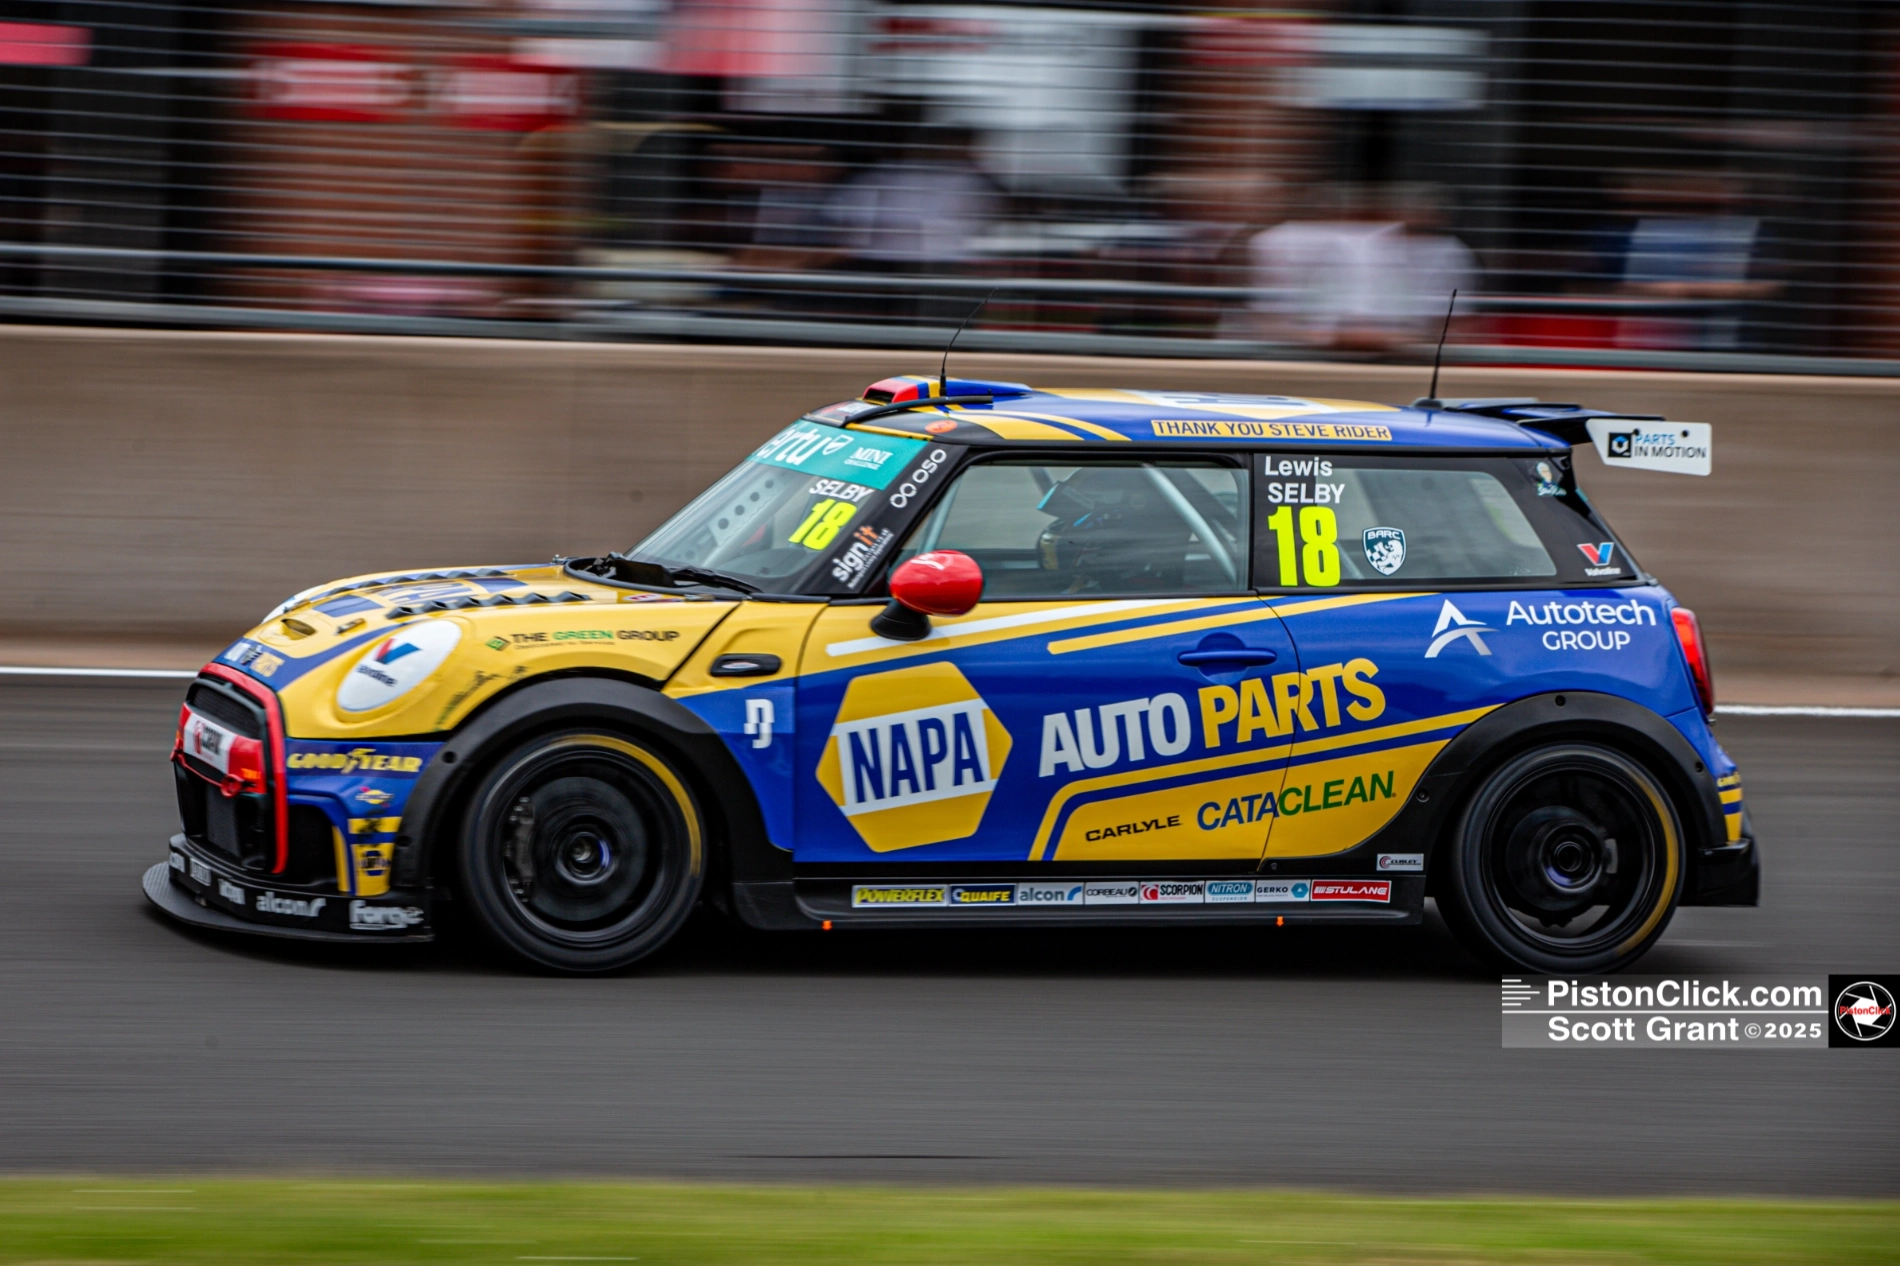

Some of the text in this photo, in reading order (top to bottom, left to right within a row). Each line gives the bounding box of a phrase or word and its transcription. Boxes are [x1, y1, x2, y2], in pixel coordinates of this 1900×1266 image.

[1154, 421, 1389, 439] THANK YOU STEVE RIDER
[1635, 434, 1676, 446] PARTS
[1634, 446, 1708, 458] IN MOTION
[1265, 455, 1333, 477] Lewis
[809, 479, 875, 502] SELBY
[1267, 482, 1345, 504] SELBY
[788, 498, 857, 551] 18
[1366, 530, 1402, 541] BARC
[1267, 506, 1341, 587] 18
[1506, 599, 1657, 626] Autotech
[510, 629, 680, 644] THE GREEN GROUP
[1542, 630, 1631, 651] GROUP
[1038, 657, 1387, 778] AUTO PARTS
[286, 748, 423, 774] GOODYEAR
[847, 711, 988, 804] NAPA
[1197, 770, 1395, 831] CATACLEAN
[1085, 814, 1181, 842] CARLYLE
[857, 888, 945, 904] POWERFLEX
[960, 891, 1011, 903] QUAIFE
[1019, 887, 1065, 902] alcon
[1085, 888, 1128, 897] CORBEAU
[1159, 884, 1203, 896] SCORPION
[1210, 884, 1250, 894] NITRON
[1256, 886, 1288, 894] GERKO
